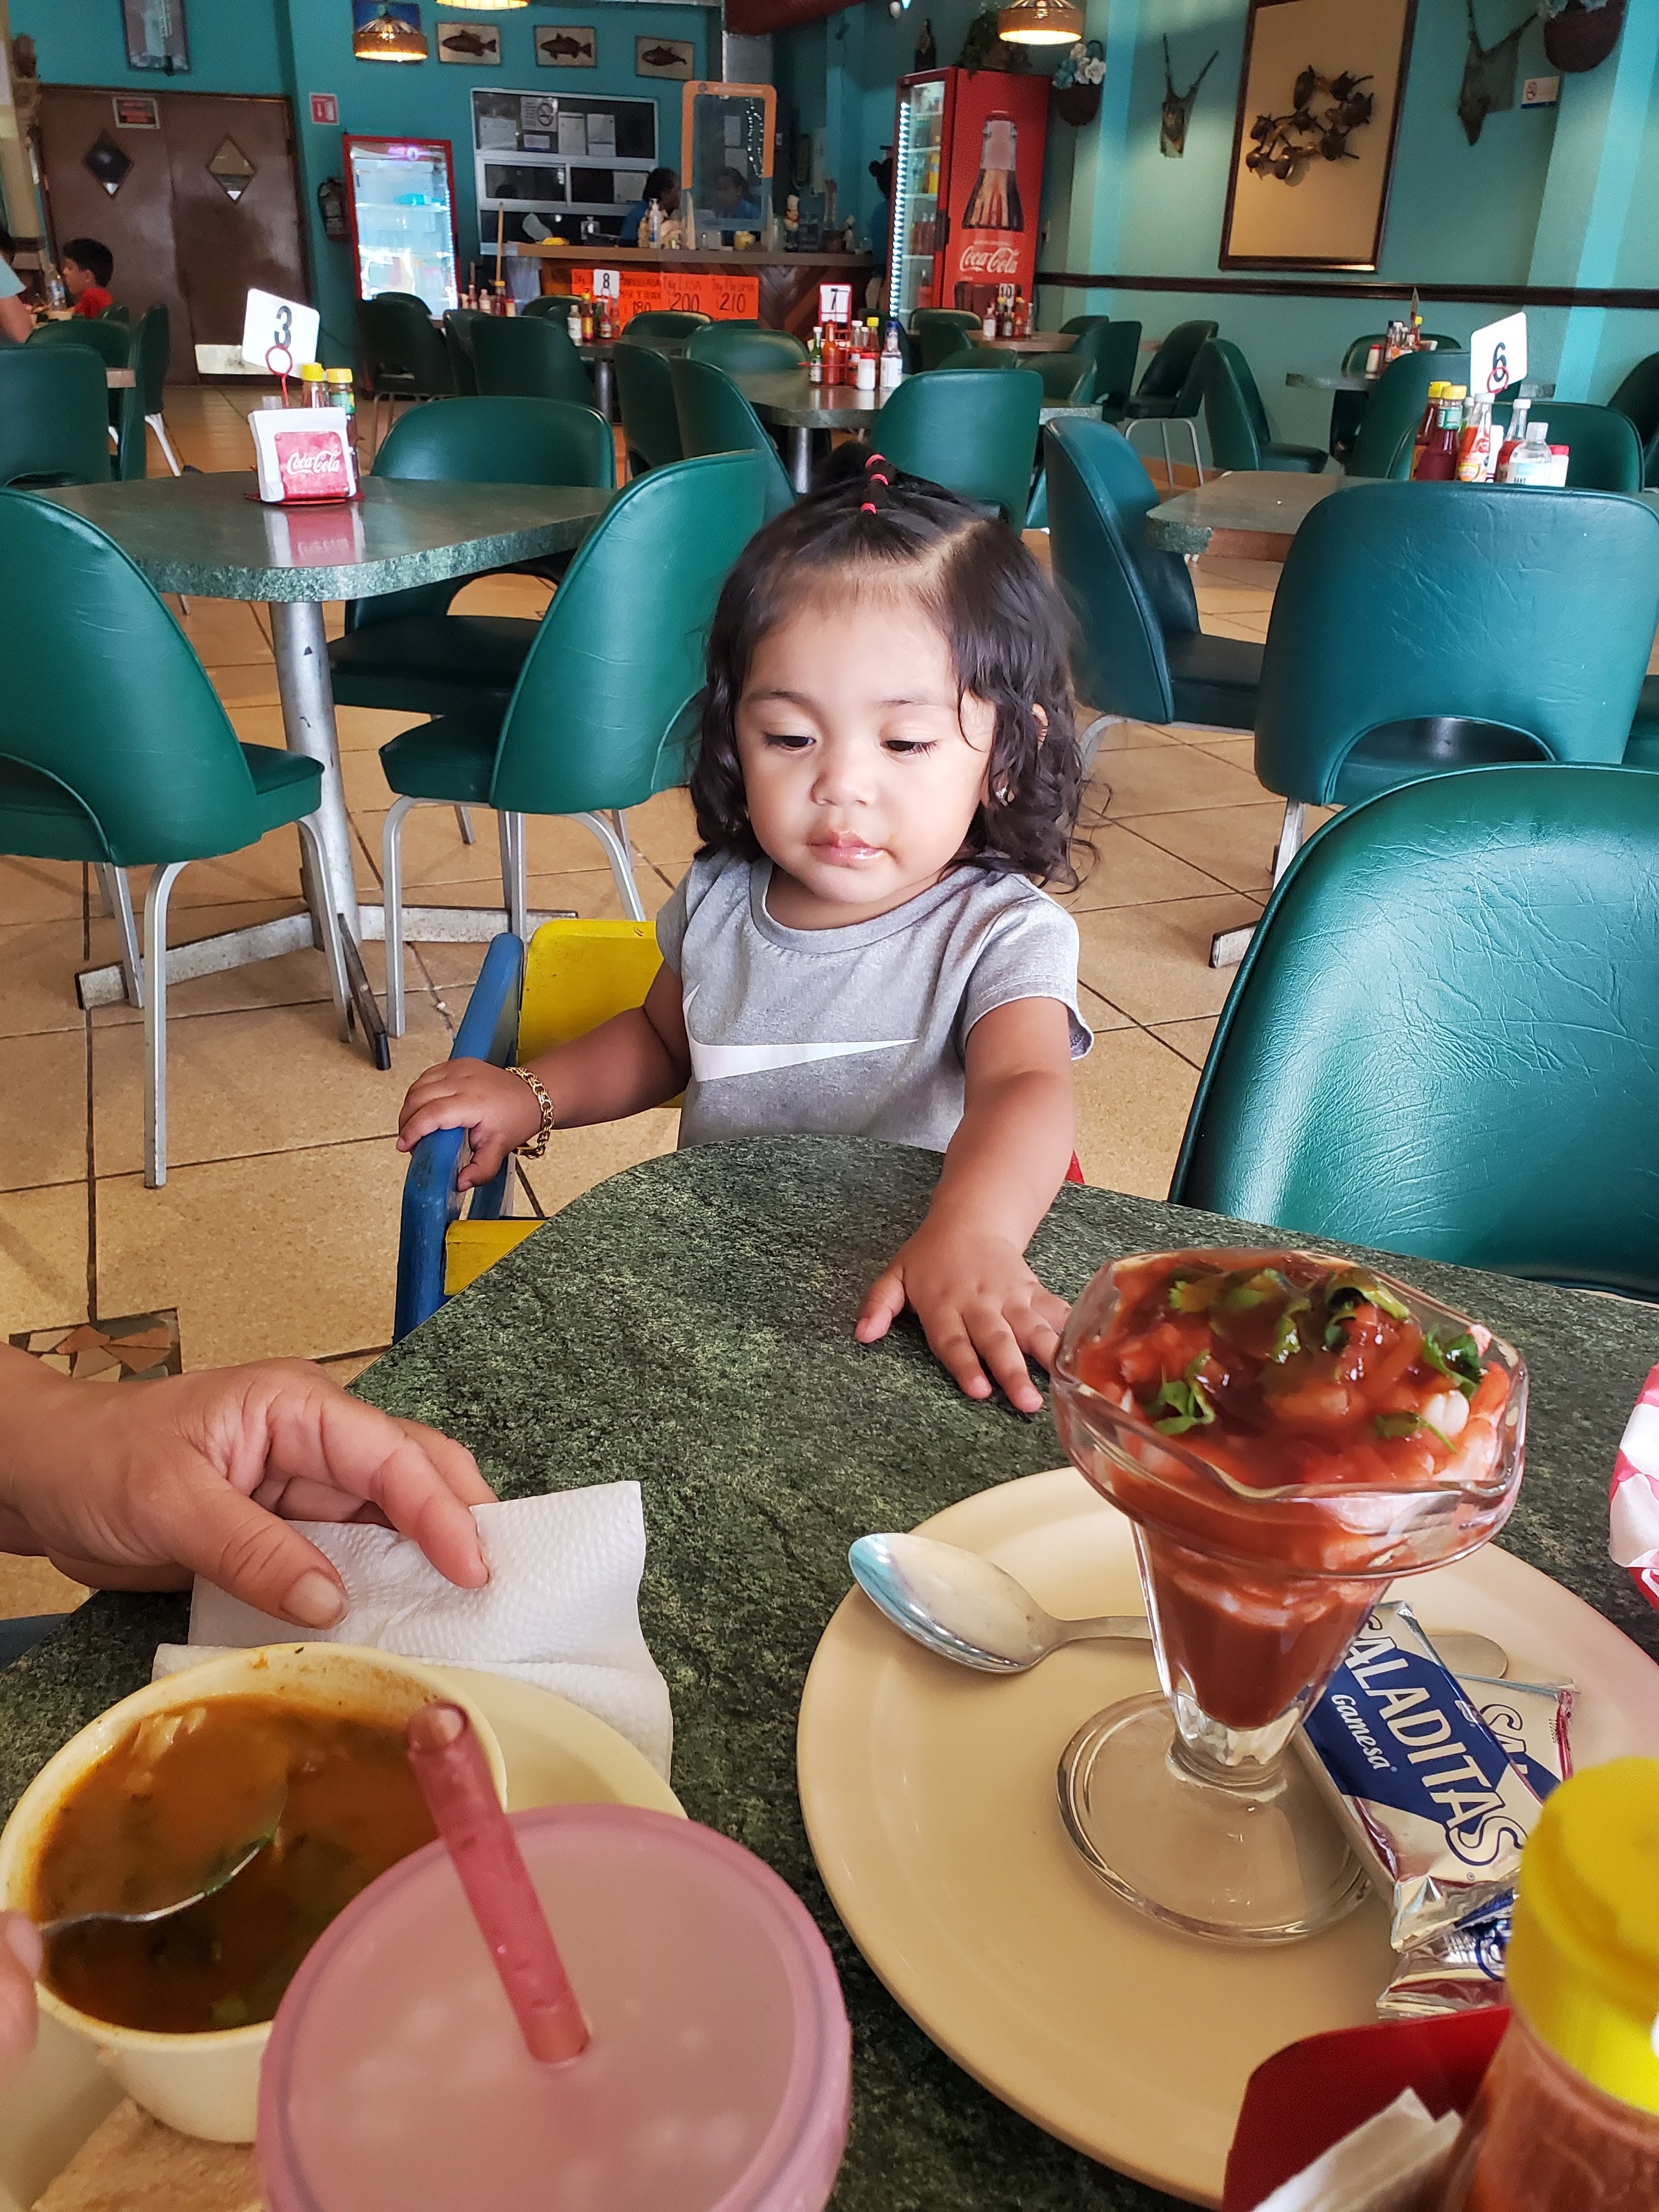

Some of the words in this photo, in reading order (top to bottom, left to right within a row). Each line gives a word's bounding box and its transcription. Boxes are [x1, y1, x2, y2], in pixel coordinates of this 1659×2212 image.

[603, 273, 610, 289] 8
[670, 292, 699, 311] 200
[719, 292, 746, 313] 210
[274, 305, 292, 350] 3
[1492, 342, 1507, 382] 6
[286, 449, 341, 476] Coca-Cola
[1331, 1694, 1392, 1770] Gamesa
